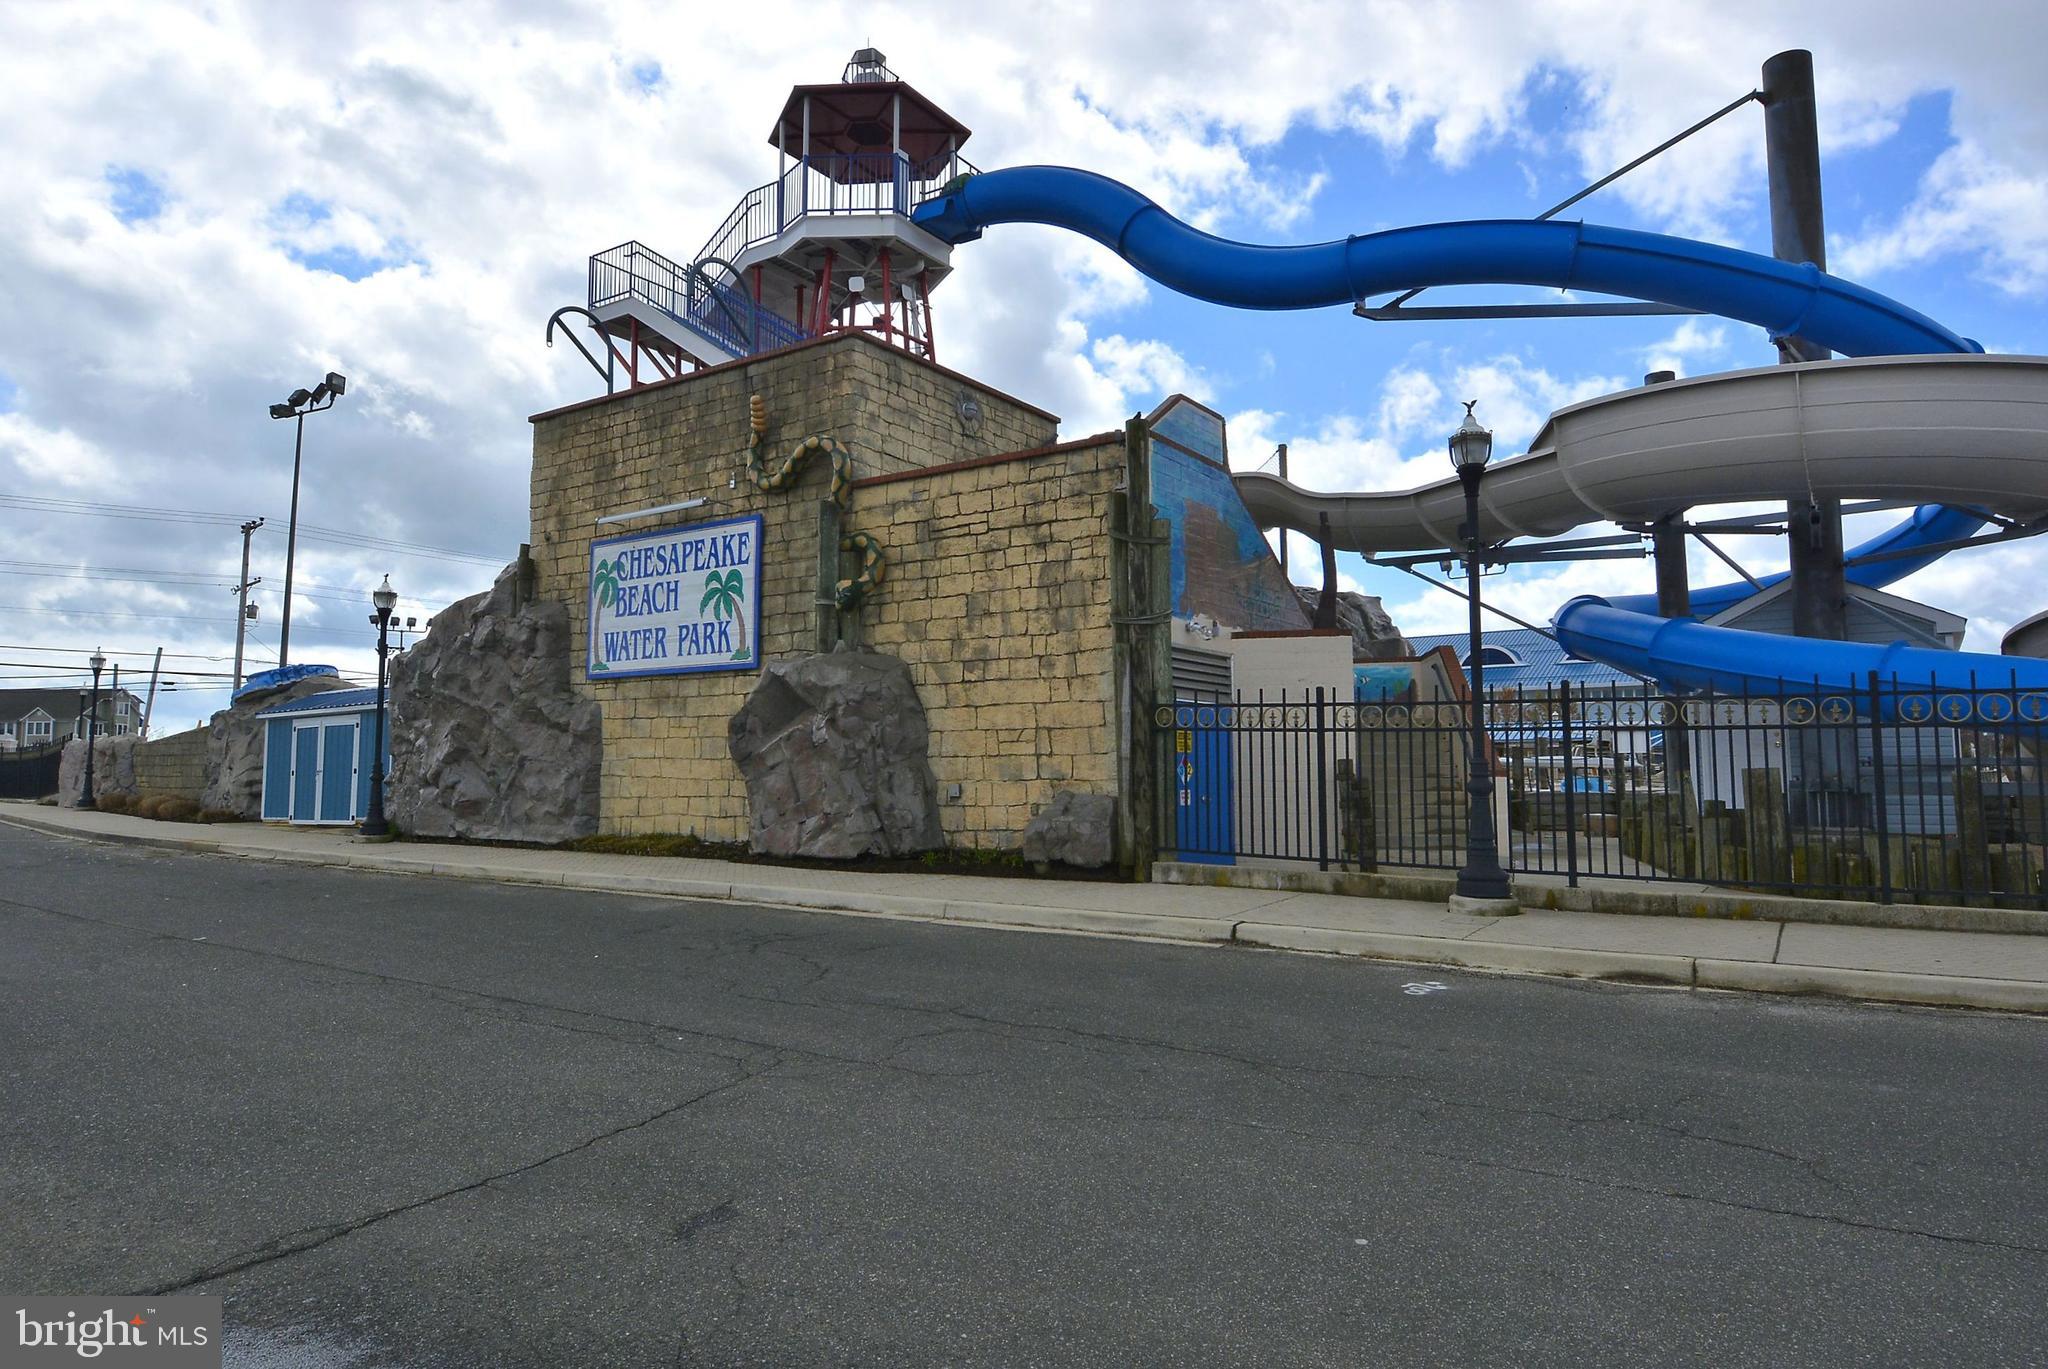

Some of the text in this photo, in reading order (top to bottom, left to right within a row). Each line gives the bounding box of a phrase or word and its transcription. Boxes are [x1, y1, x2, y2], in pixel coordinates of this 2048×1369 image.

[617, 532, 750, 581] CHESAPEAKE
[615, 580, 679, 617] BEACH
[604, 621, 732, 662] WATER PARK
